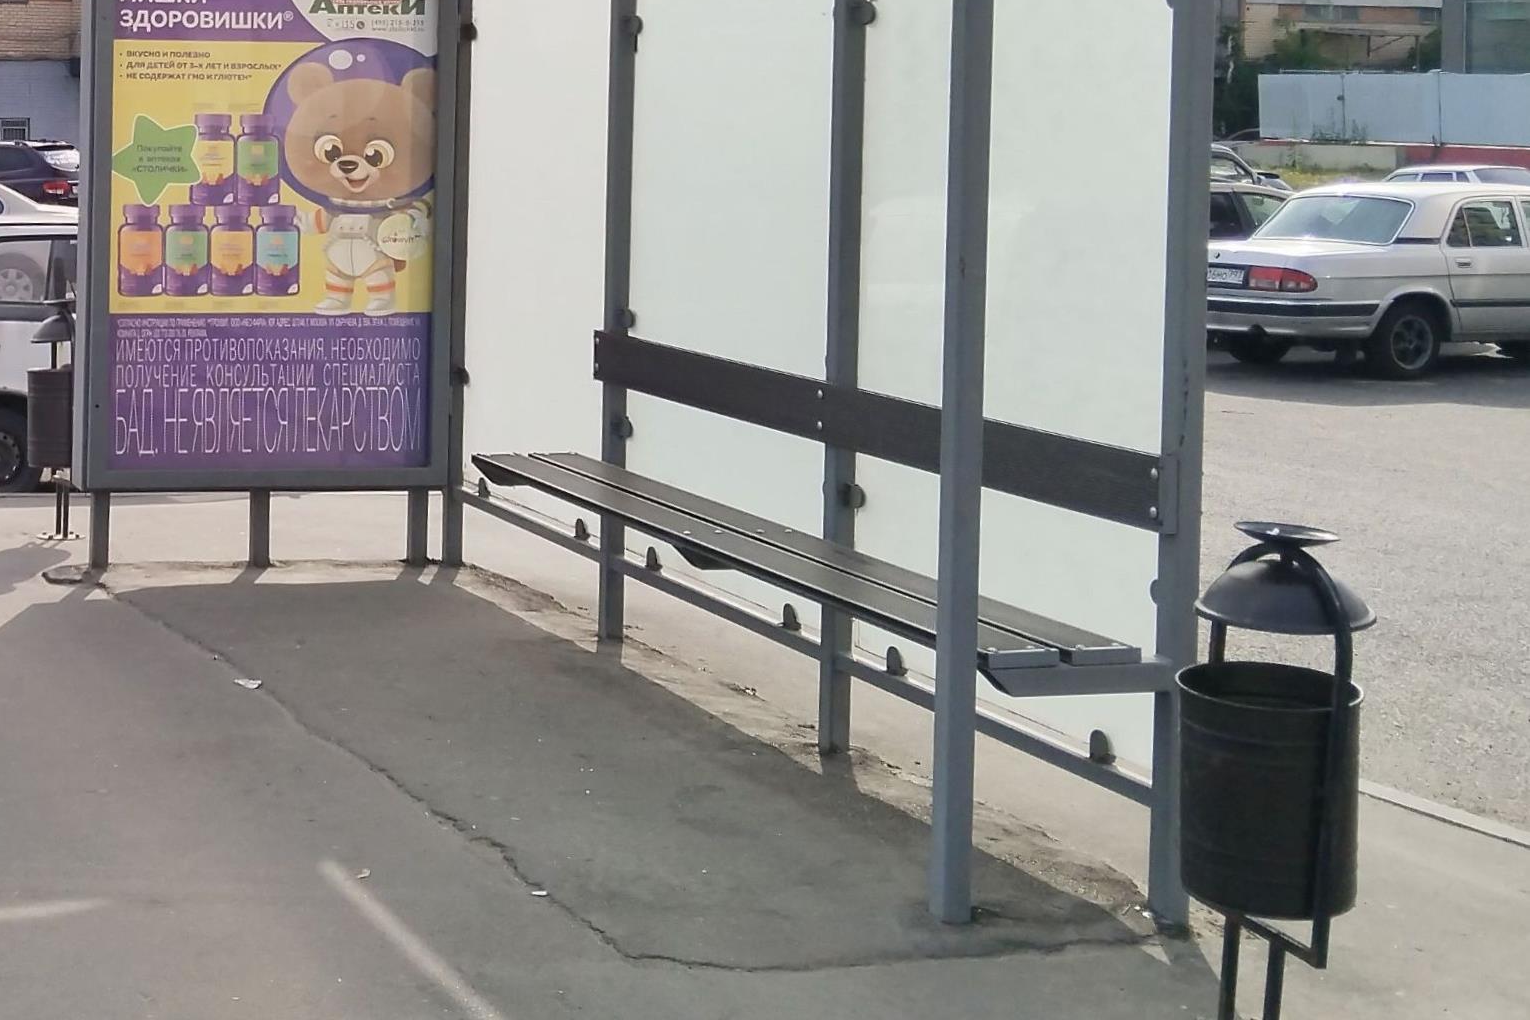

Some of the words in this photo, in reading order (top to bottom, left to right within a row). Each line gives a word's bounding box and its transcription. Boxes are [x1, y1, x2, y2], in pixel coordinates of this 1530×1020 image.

[126, 50, 162, 58] ВКУСНО
[126, 61, 145, 69] ДЛЯ
[146, 61, 176, 70] ДЕТЕЙ
[139, 72, 186, 81] СОДЕРЖАТ
[115, 338, 181, 362] ИМЕЮТСЯ
[185, 338, 327, 361] ПРОТИВОПОКАЗАНИЯ.
[331, 337, 420, 363] НЕОБХОДИМО
[115, 364, 197, 388] ПОЛУЧЕНИЕ
[207, 363, 314, 388] КОНСУЛЬТАЦИИ
[323, 363, 421, 388] СПЕЦИАЛИСТА
[115, 389, 158, 456] БАД.
[164, 389, 188, 453] НЕ
[192, 388, 289, 454] ЯВЛЯЕТСЯ
[292, 387, 421, 453] ЛЕКАРСТВОМ
